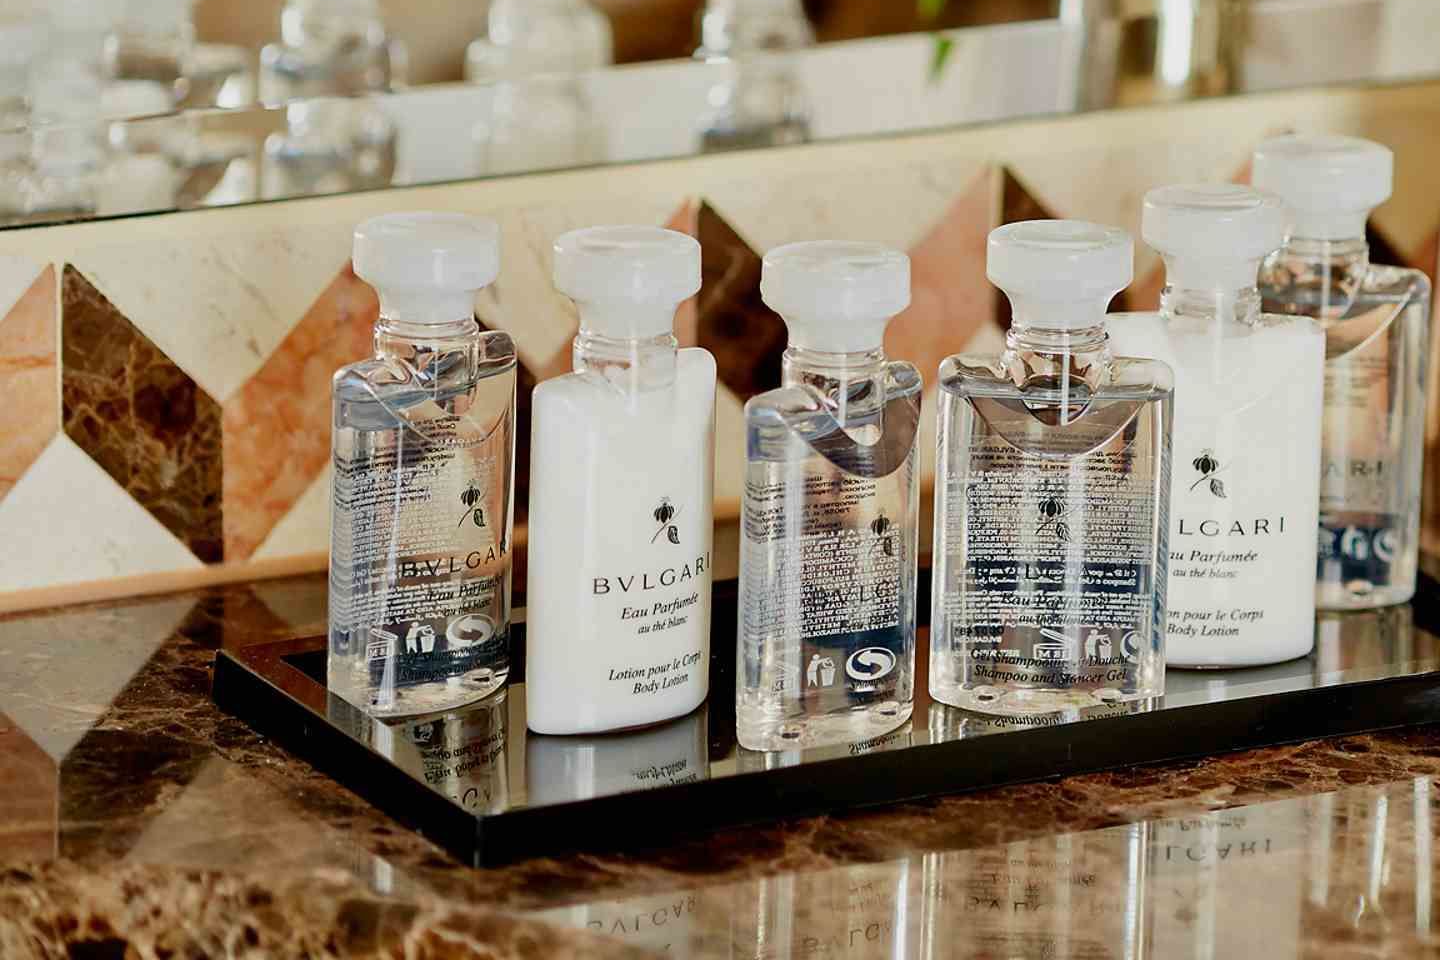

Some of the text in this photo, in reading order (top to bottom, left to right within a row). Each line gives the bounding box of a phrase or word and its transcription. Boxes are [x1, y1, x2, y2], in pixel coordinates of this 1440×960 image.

[1190, 549, 1259, 565] Parfumée
[593, 551, 710, 595] BVLGARI
[621, 606, 648, 620] Eau
[1183, 610, 1213, 623] pour
[1230, 608, 1265, 623] Corps
[638, 624, 651, 635] au
[1200, 624, 1240, 637] Lotion
[608, 668, 646, 682] Lotion
[647, 662, 672, 680] pour
[974, 665, 1029, 683] Shampoo
[1030, 670, 1055, 684] and
[1106, 668, 1127, 682] Gel
[632, 673, 689, 695] Body Lotion
